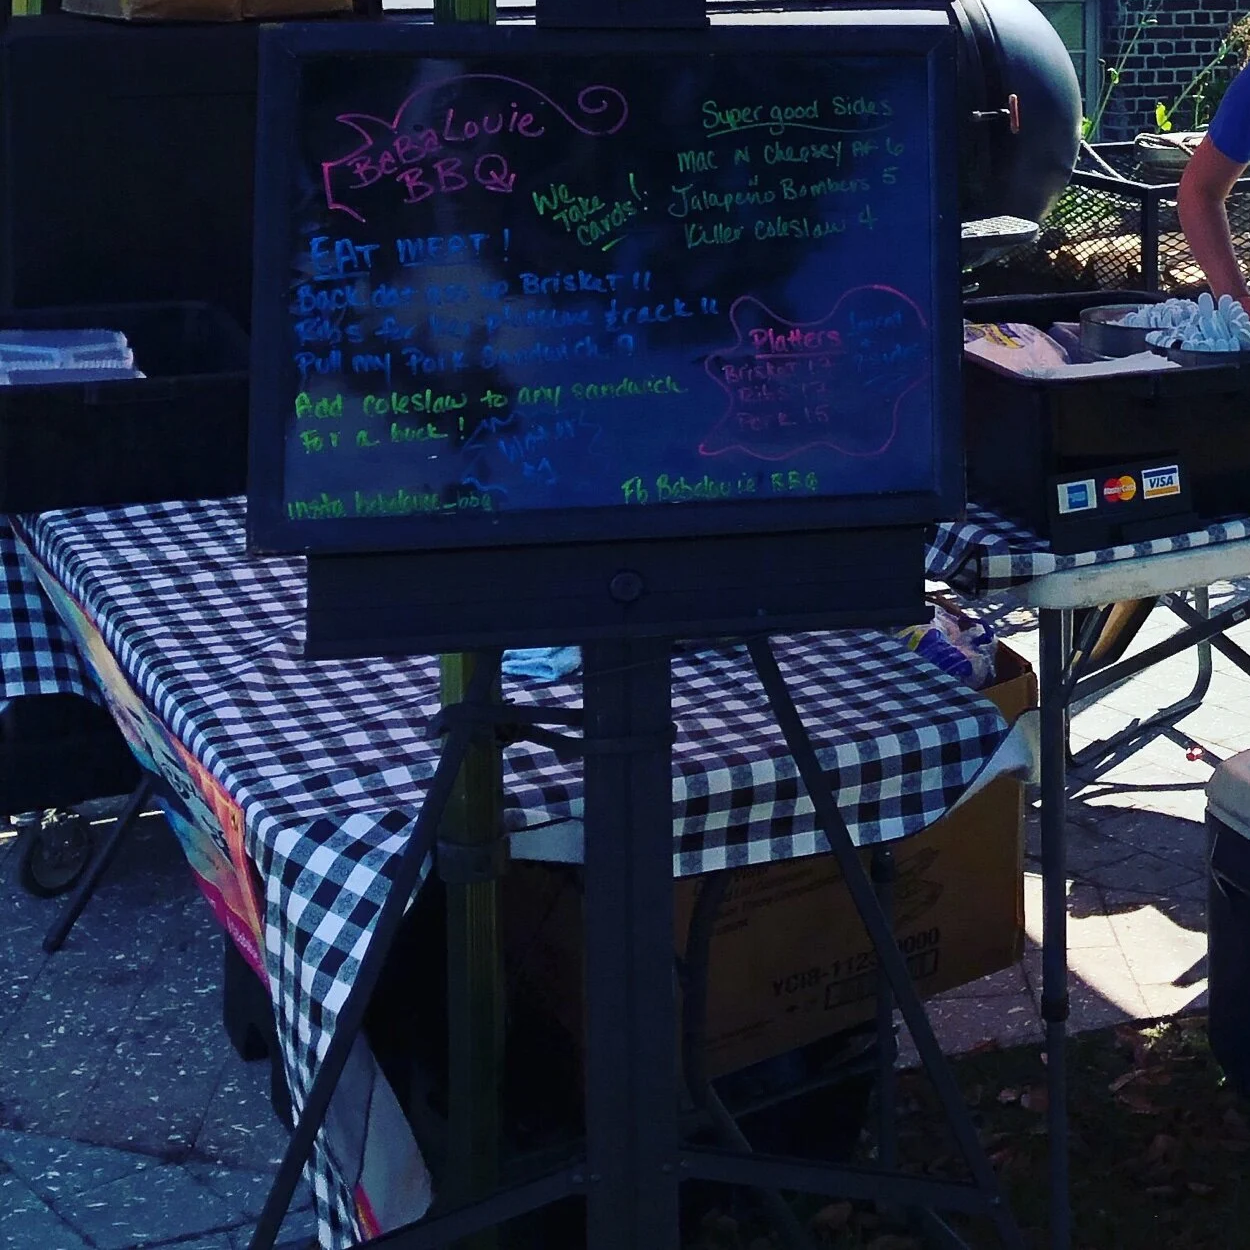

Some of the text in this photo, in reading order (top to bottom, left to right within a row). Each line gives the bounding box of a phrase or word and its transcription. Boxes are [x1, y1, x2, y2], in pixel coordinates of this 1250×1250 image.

[702, 100, 763, 130] Super
[770, 100, 819, 136] good
[396, 153, 517, 204] BBQ
[309, 234, 380, 275] EAT
[395, 232, 491, 265] MEAT
[748, 327, 842, 353] Platters
[294, 348, 344, 382] Pull
[351, 350, 393, 384] my
[294, 390, 343, 419] Add
[479, 389, 509, 410] to
[518, 384, 562, 407] any
[571, 374, 689, 400] sandwich
[1149, 475, 1174, 489] VISA
